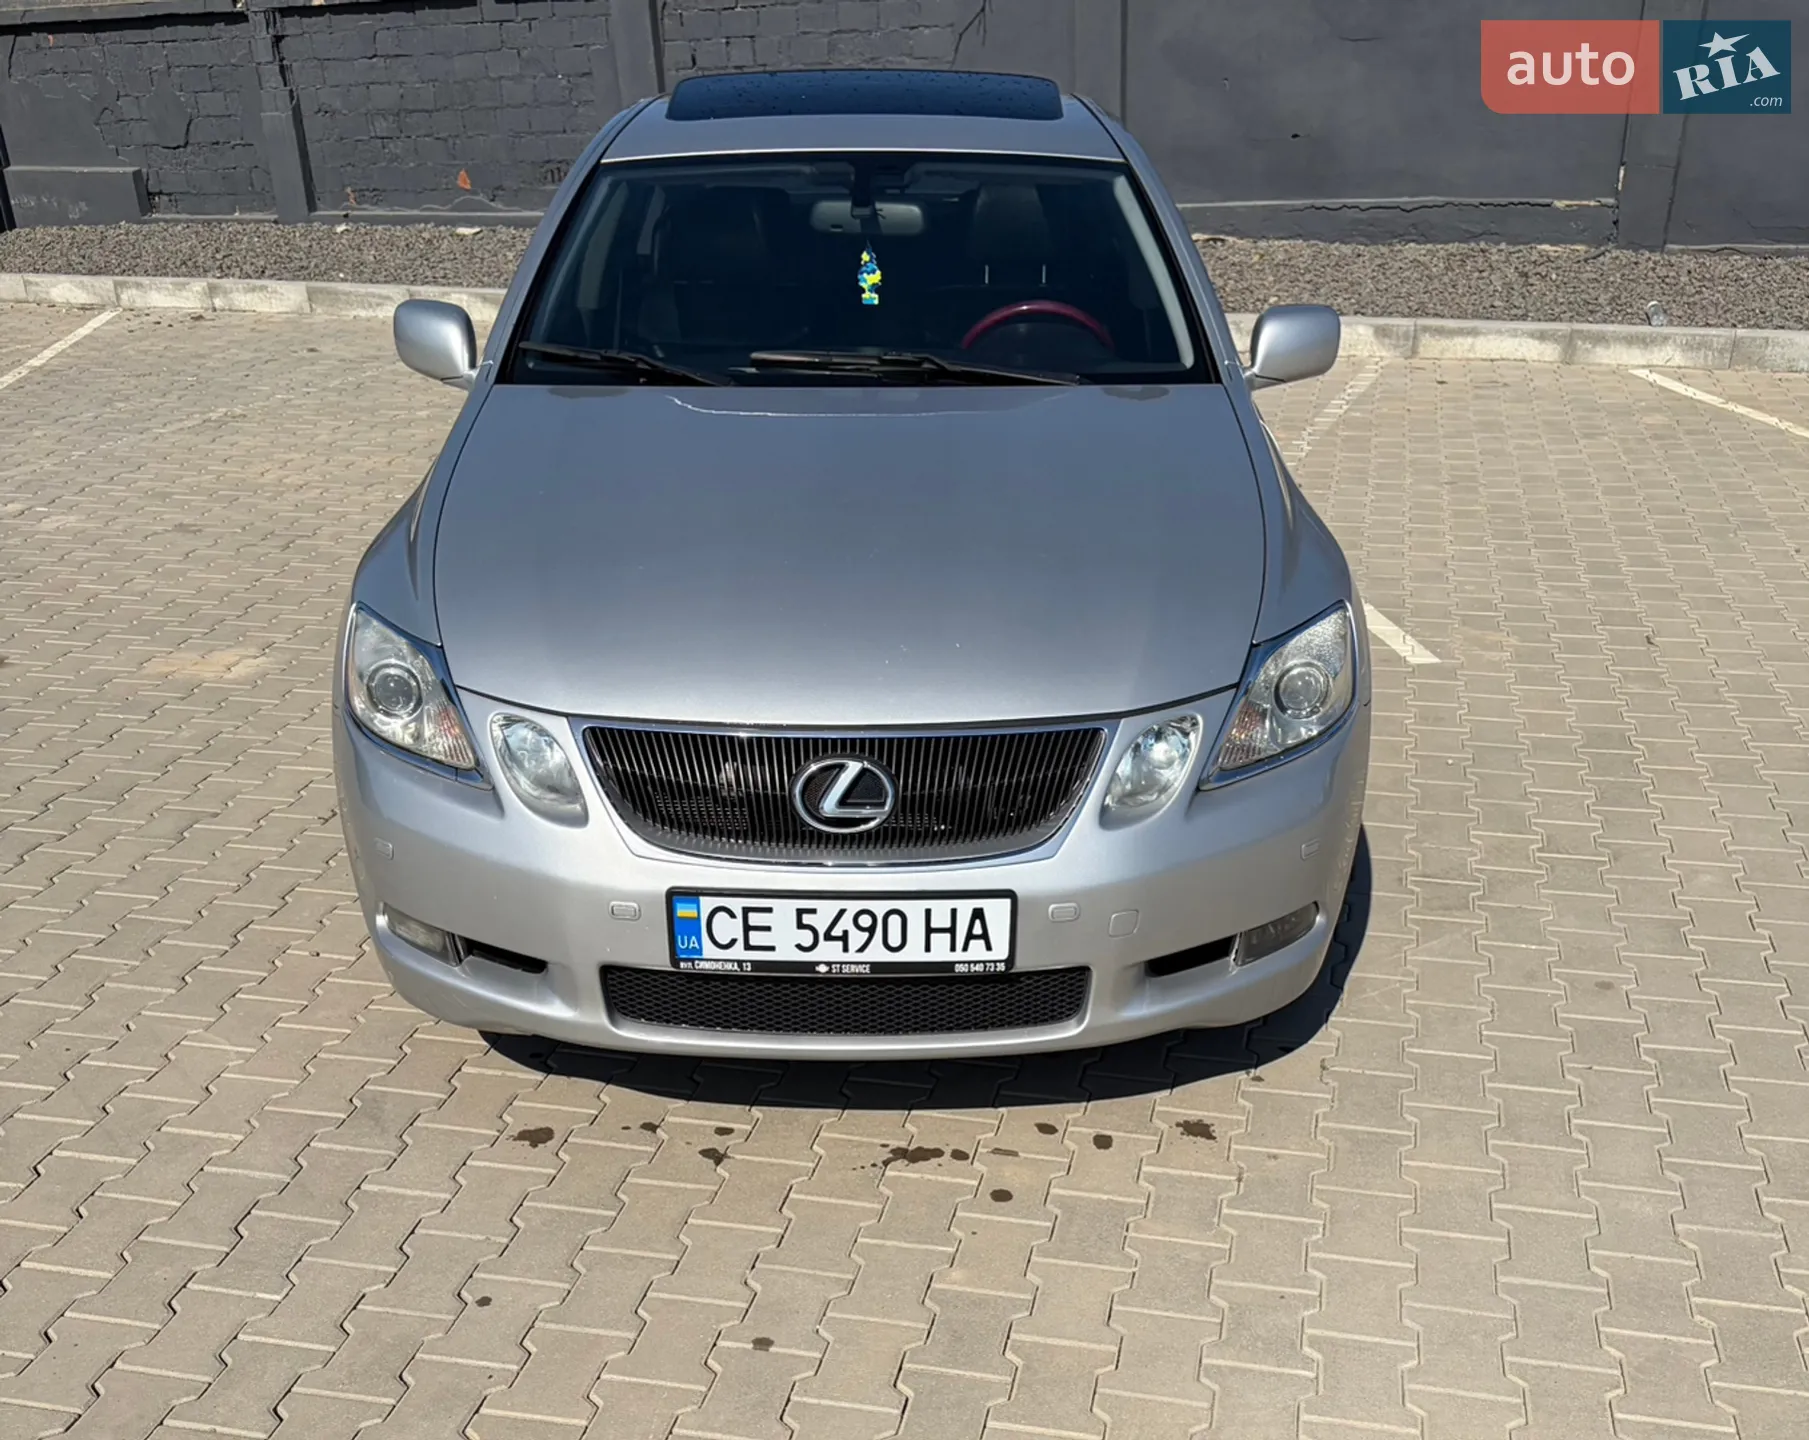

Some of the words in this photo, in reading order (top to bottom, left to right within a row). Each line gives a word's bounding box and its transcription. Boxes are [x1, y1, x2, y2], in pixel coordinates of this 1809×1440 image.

[706, 905, 776, 952] CE
[794, 907, 908, 953] 5490
[924, 907, 993, 953] HA
[677, 935, 700, 949] UA
[742, 962, 752, 971] 13
[831, 963, 841, 974] ST
[841, 963, 871, 974] SERVICE
